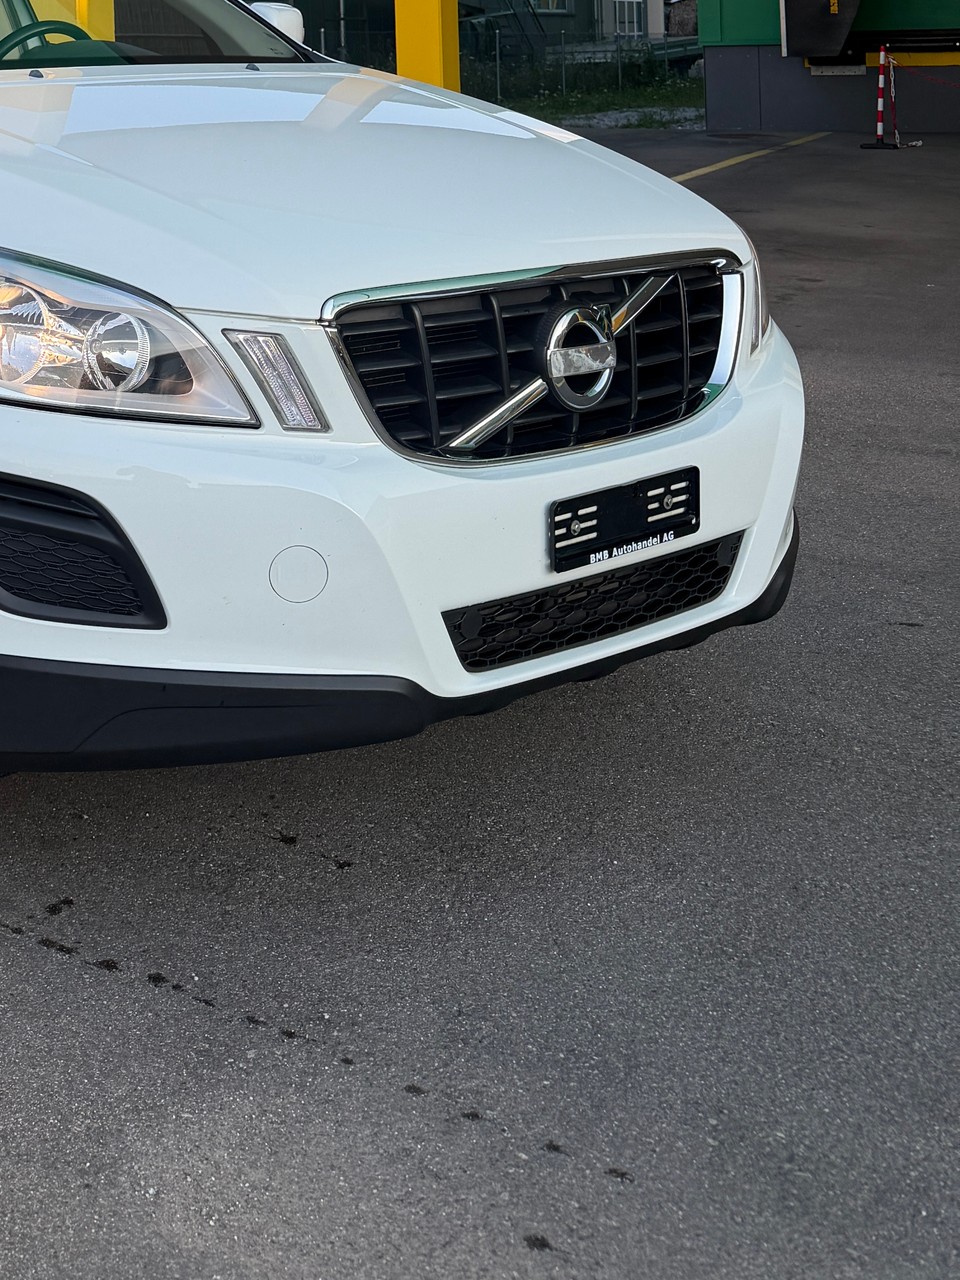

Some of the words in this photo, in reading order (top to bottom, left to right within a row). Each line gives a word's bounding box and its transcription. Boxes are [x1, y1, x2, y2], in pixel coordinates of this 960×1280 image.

[589, 549, 609, 564] BMB
[612, 534, 660, 557] Autohandel
[662, 530, 675, 543] AG
